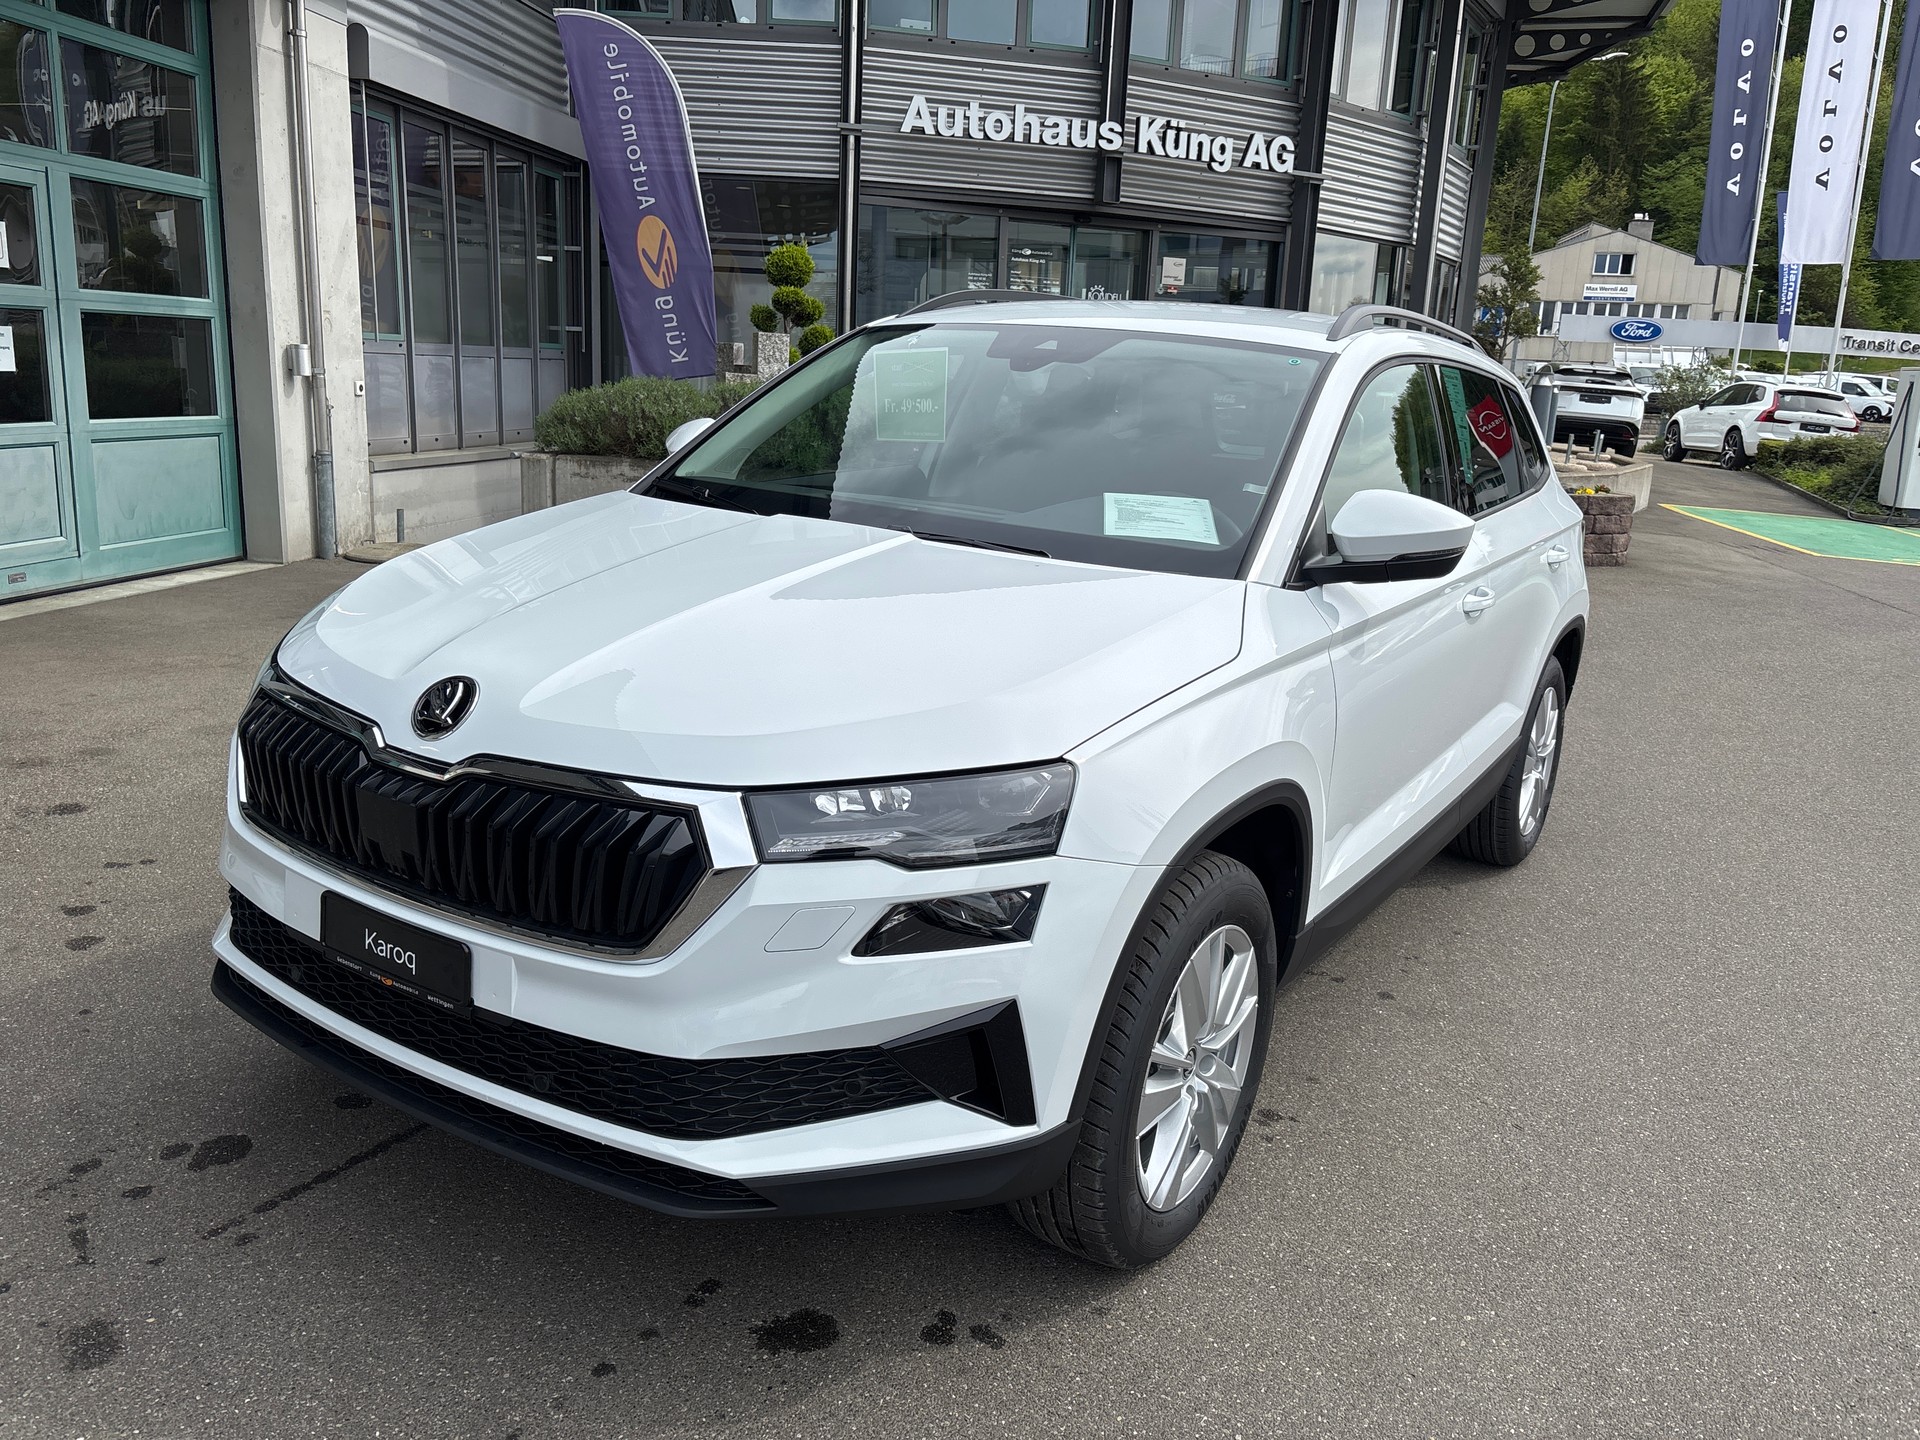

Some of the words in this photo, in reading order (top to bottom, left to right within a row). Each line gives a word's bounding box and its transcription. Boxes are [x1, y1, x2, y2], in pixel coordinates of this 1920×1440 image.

[901, 94, 1123, 151] Autohaus
[1136, 115, 1234, 173] Küng
[1240, 132, 1297, 173] AG
[1620, 321, 1654, 338] Ford
[1842, 335, 1896, 352] Transit
[884, 398, 899, 413] Fr.
[364, 927, 416, 975] Karoq
